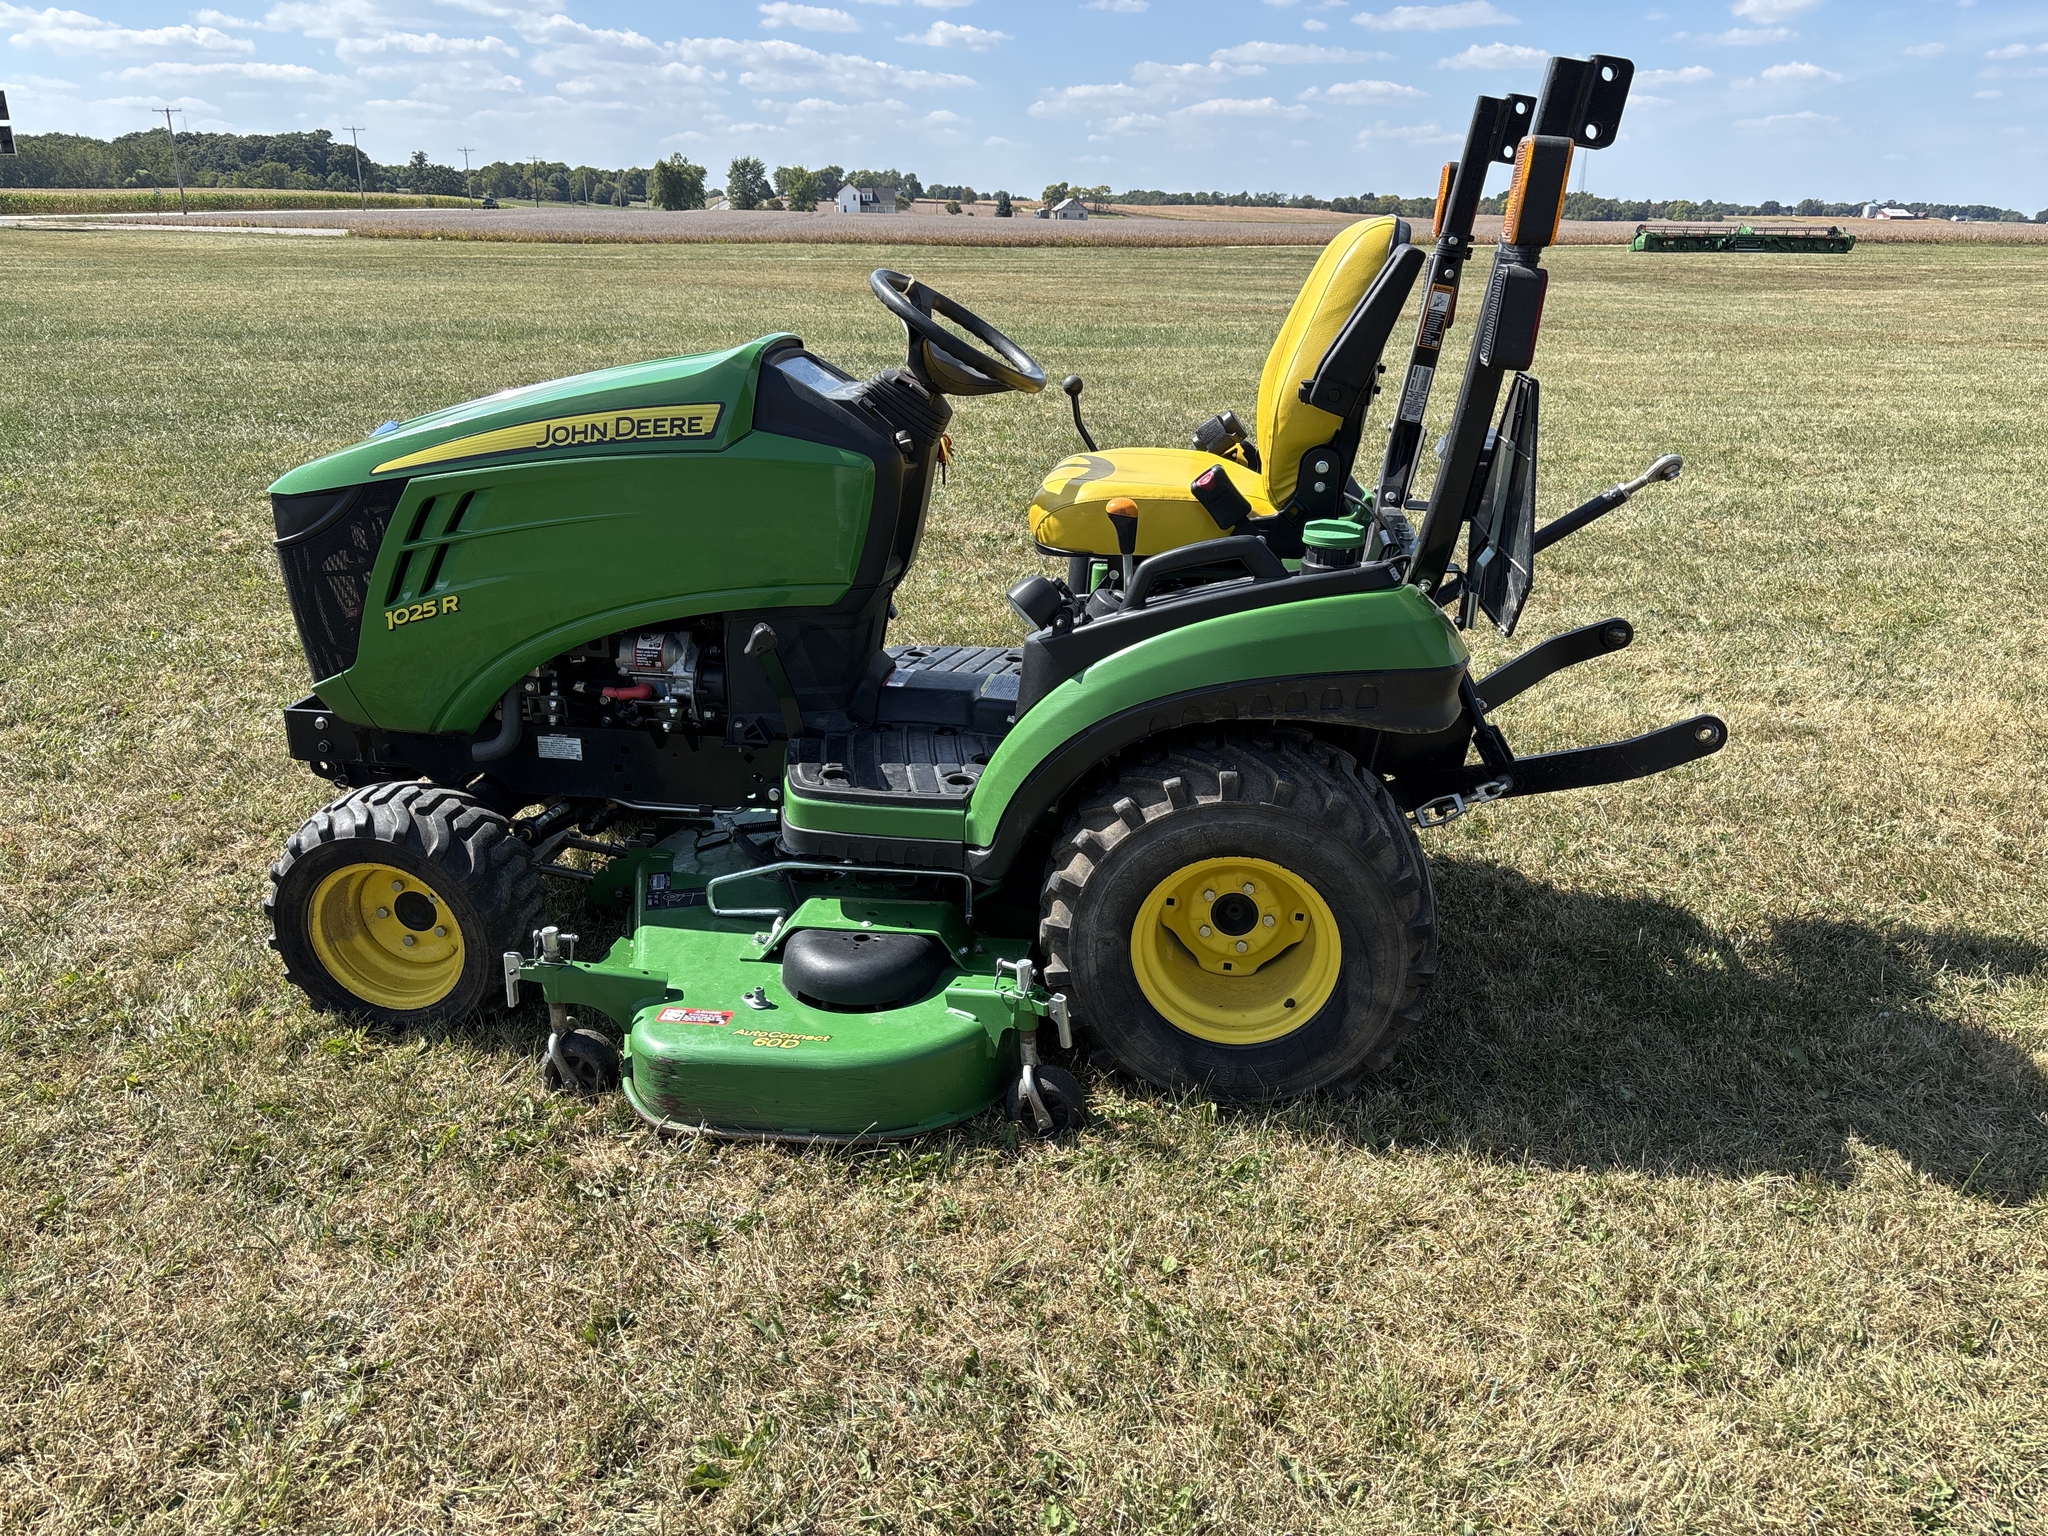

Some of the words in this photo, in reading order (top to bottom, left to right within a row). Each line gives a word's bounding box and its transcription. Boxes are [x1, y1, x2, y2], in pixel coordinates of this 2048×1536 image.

[535, 422, 608, 446] JOHN
[614, 416, 703, 438] DEERE
[385, 600, 438, 631] 1025
[442, 595, 460, 615] R
[730, 1028, 833, 1042] AutoConnect
[751, 1037, 801, 1049] 60D
